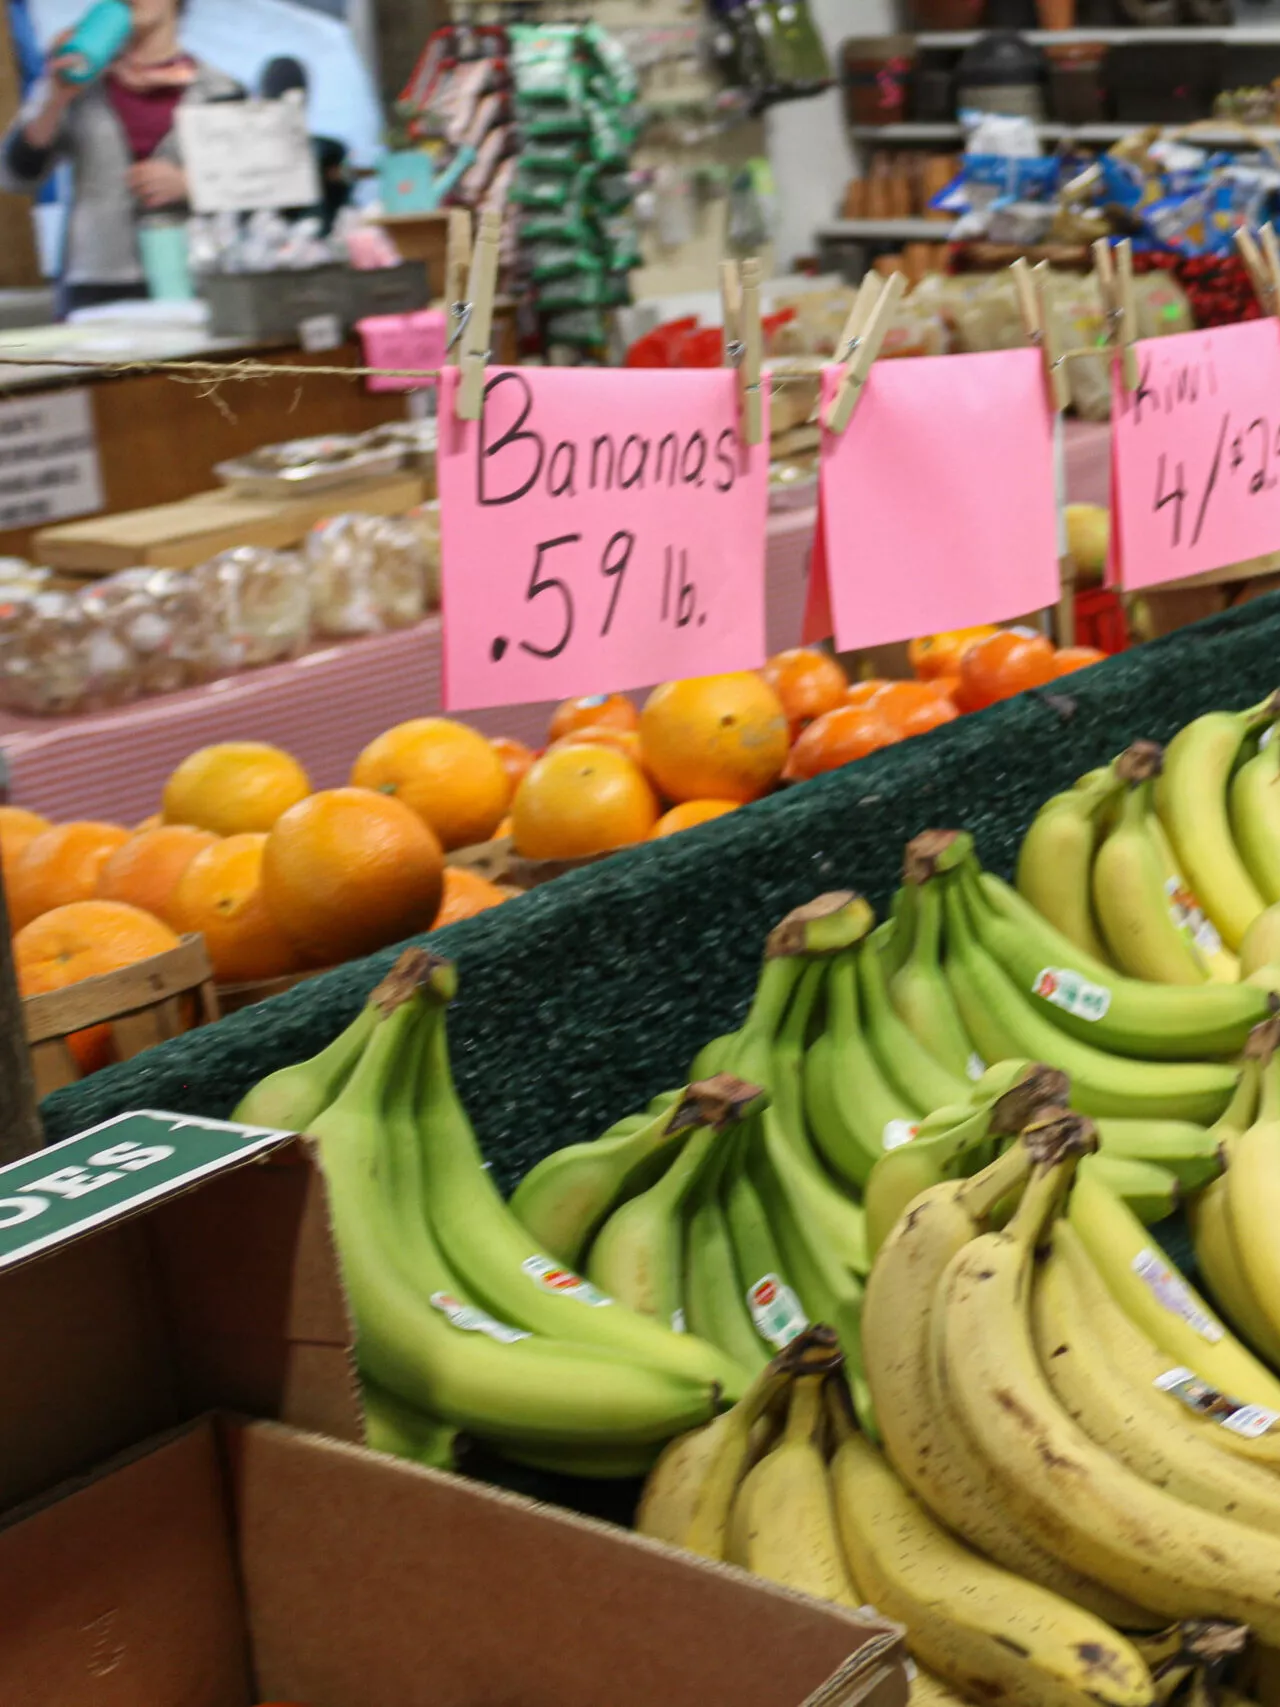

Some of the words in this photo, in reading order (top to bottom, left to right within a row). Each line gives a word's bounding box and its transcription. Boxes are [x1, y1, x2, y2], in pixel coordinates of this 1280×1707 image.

[477, 371, 739, 506] Bananas
[489, 529, 635, 662] .59
[660, 544, 707, 628] lb.
